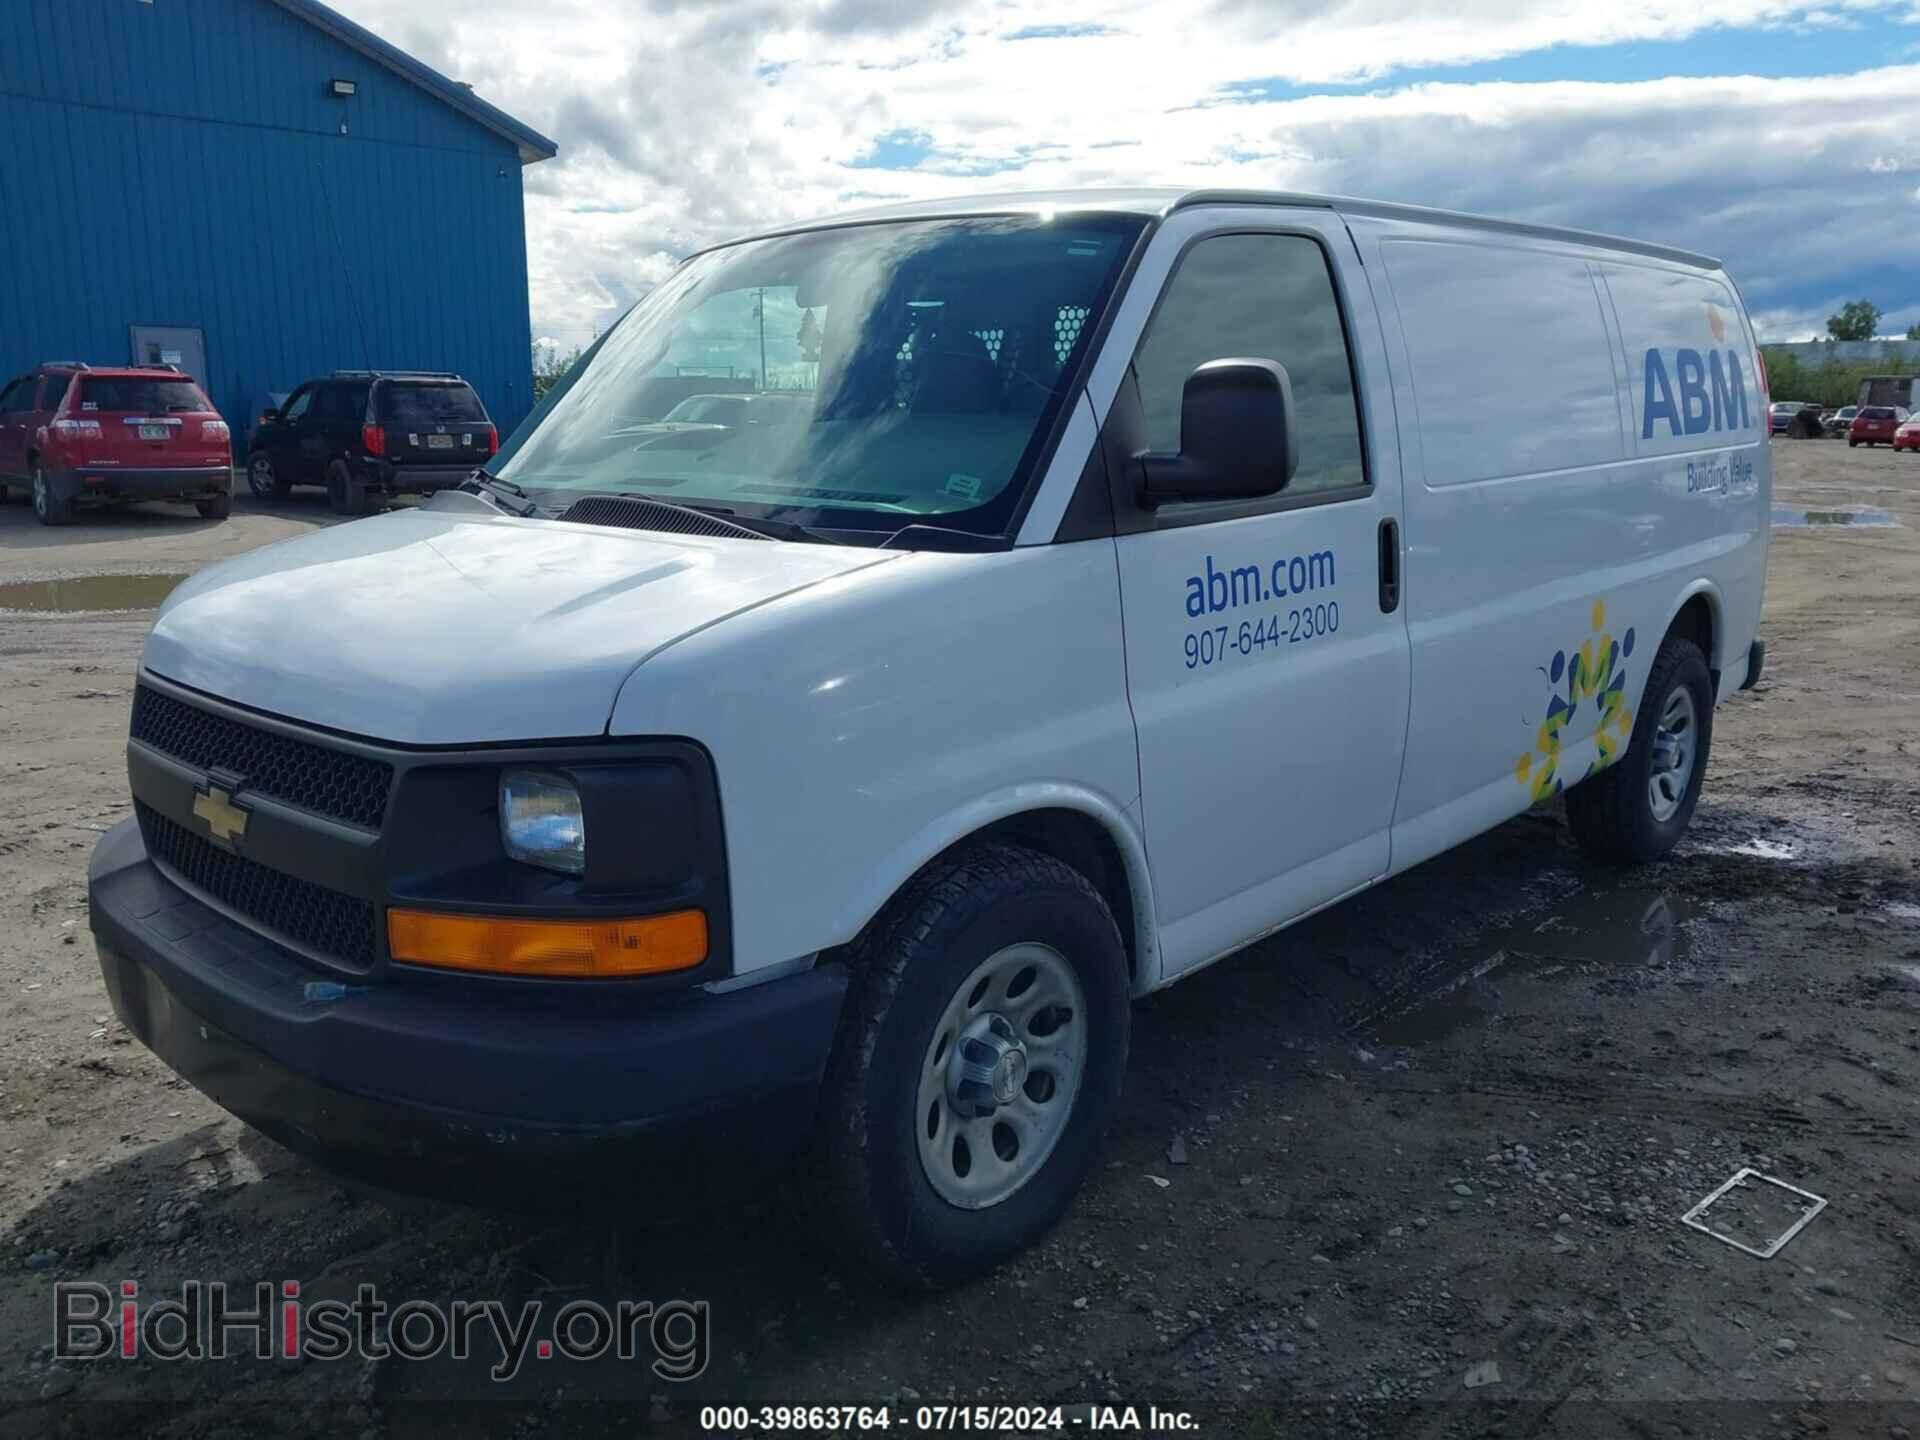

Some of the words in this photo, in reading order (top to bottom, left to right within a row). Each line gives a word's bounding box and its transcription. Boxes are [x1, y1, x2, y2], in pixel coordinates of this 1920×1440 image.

[1642, 348, 1750, 440] ABM
[1687, 461, 1728, 495] Building
[1185, 550, 1336, 618] abm.com
[1184, 601, 1339, 669] 907-644-2300
